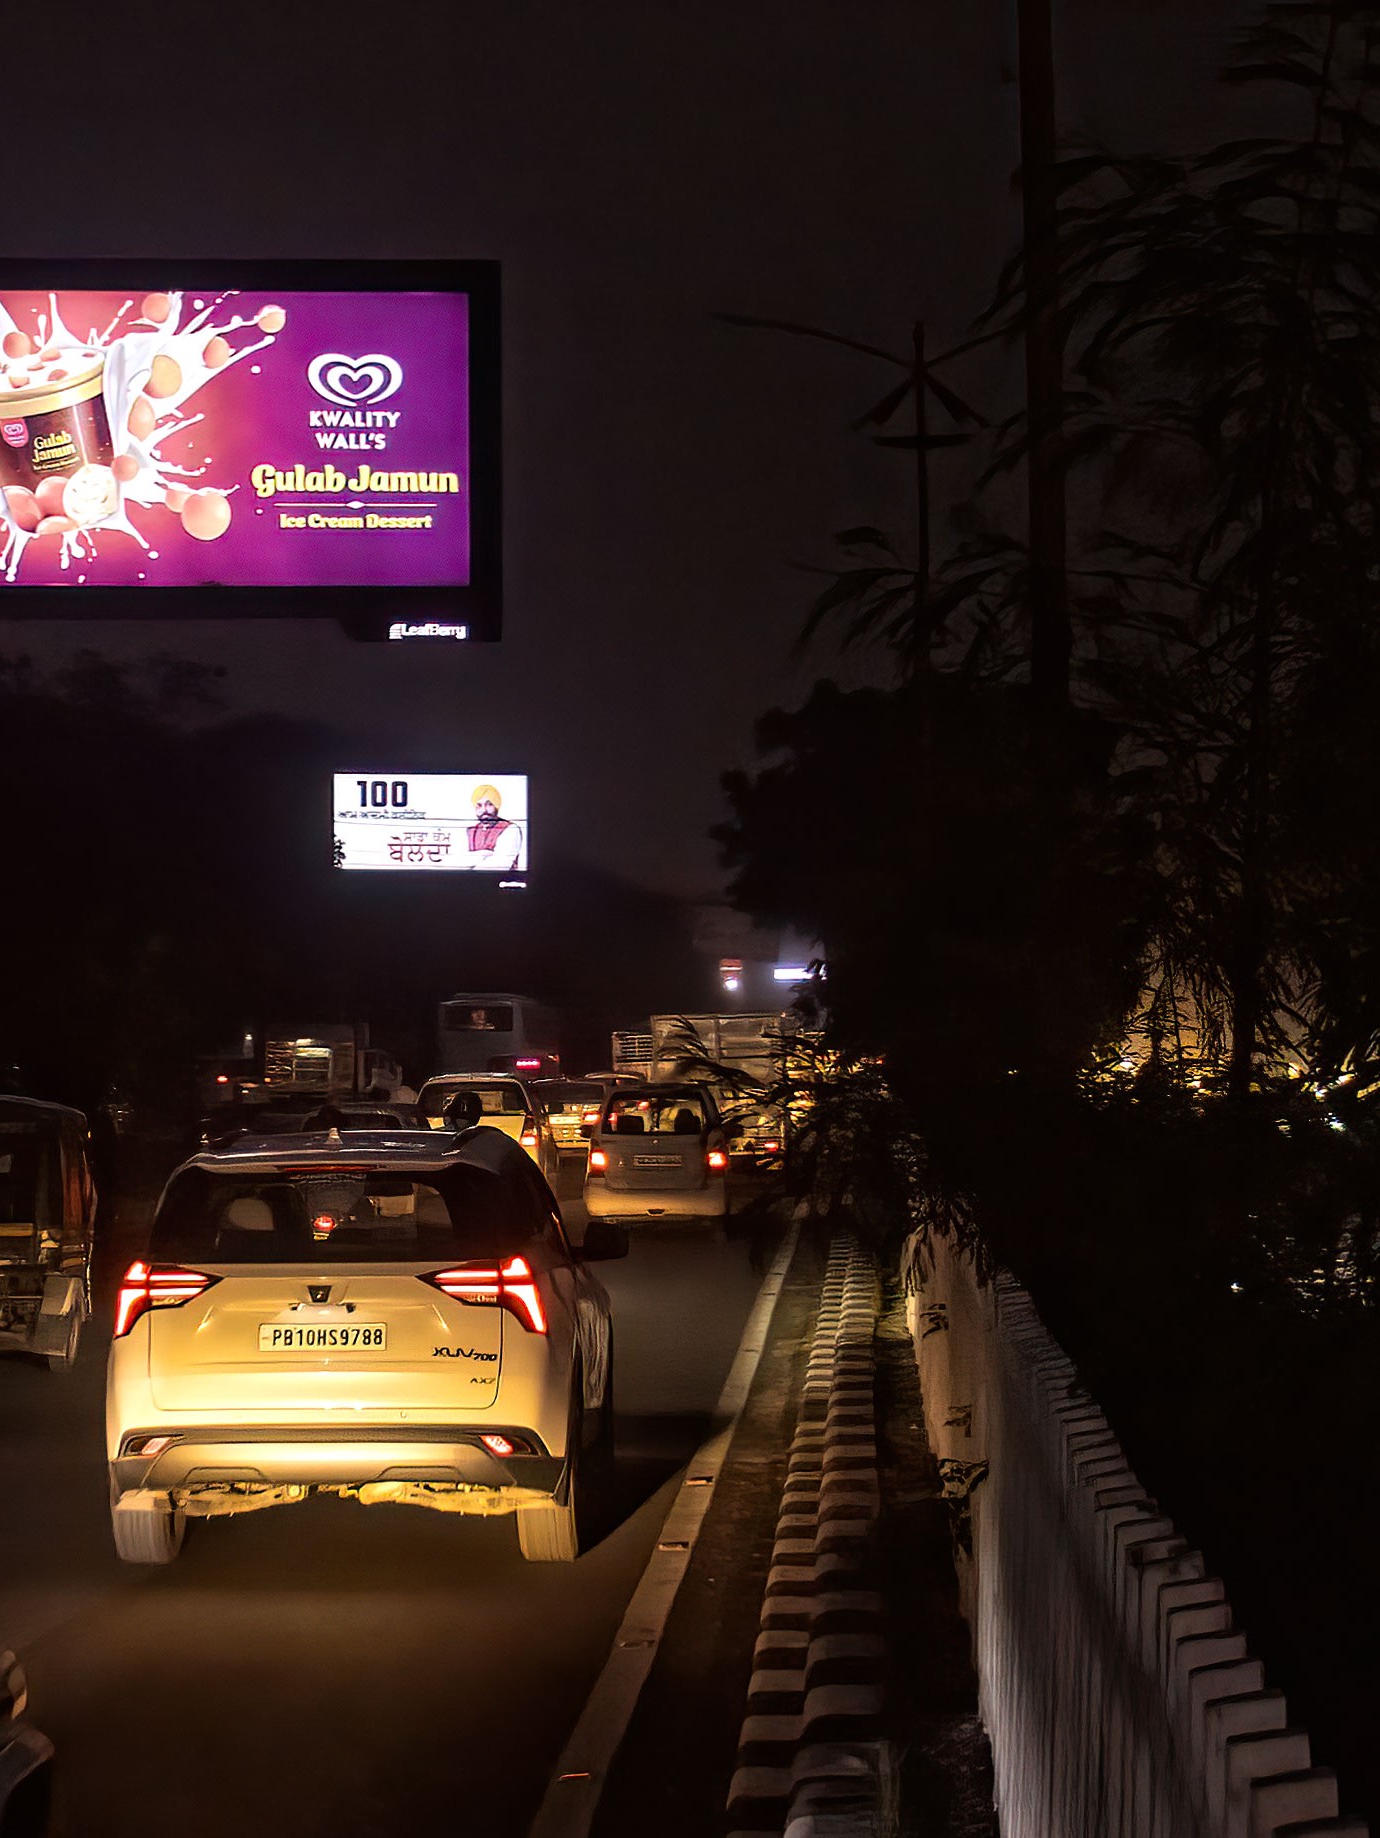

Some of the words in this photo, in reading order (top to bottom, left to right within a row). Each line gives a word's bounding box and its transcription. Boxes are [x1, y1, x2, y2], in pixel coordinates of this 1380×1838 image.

[309, 411, 401, 427] KWALITY
[34, 430, 72, 449] Gulab
[315, 433, 386, 449] WALL'S
[251, 464, 346, 497] Gulab
[348, 465, 459, 492] Jamun
[280, 514, 307, 528] Ice
[308, 514, 364, 528] Cream
[366, 514, 432, 528] Dessert
[357, 780, 408, 807] 100
[272, 1329, 383, 1346] PB10HS9788
